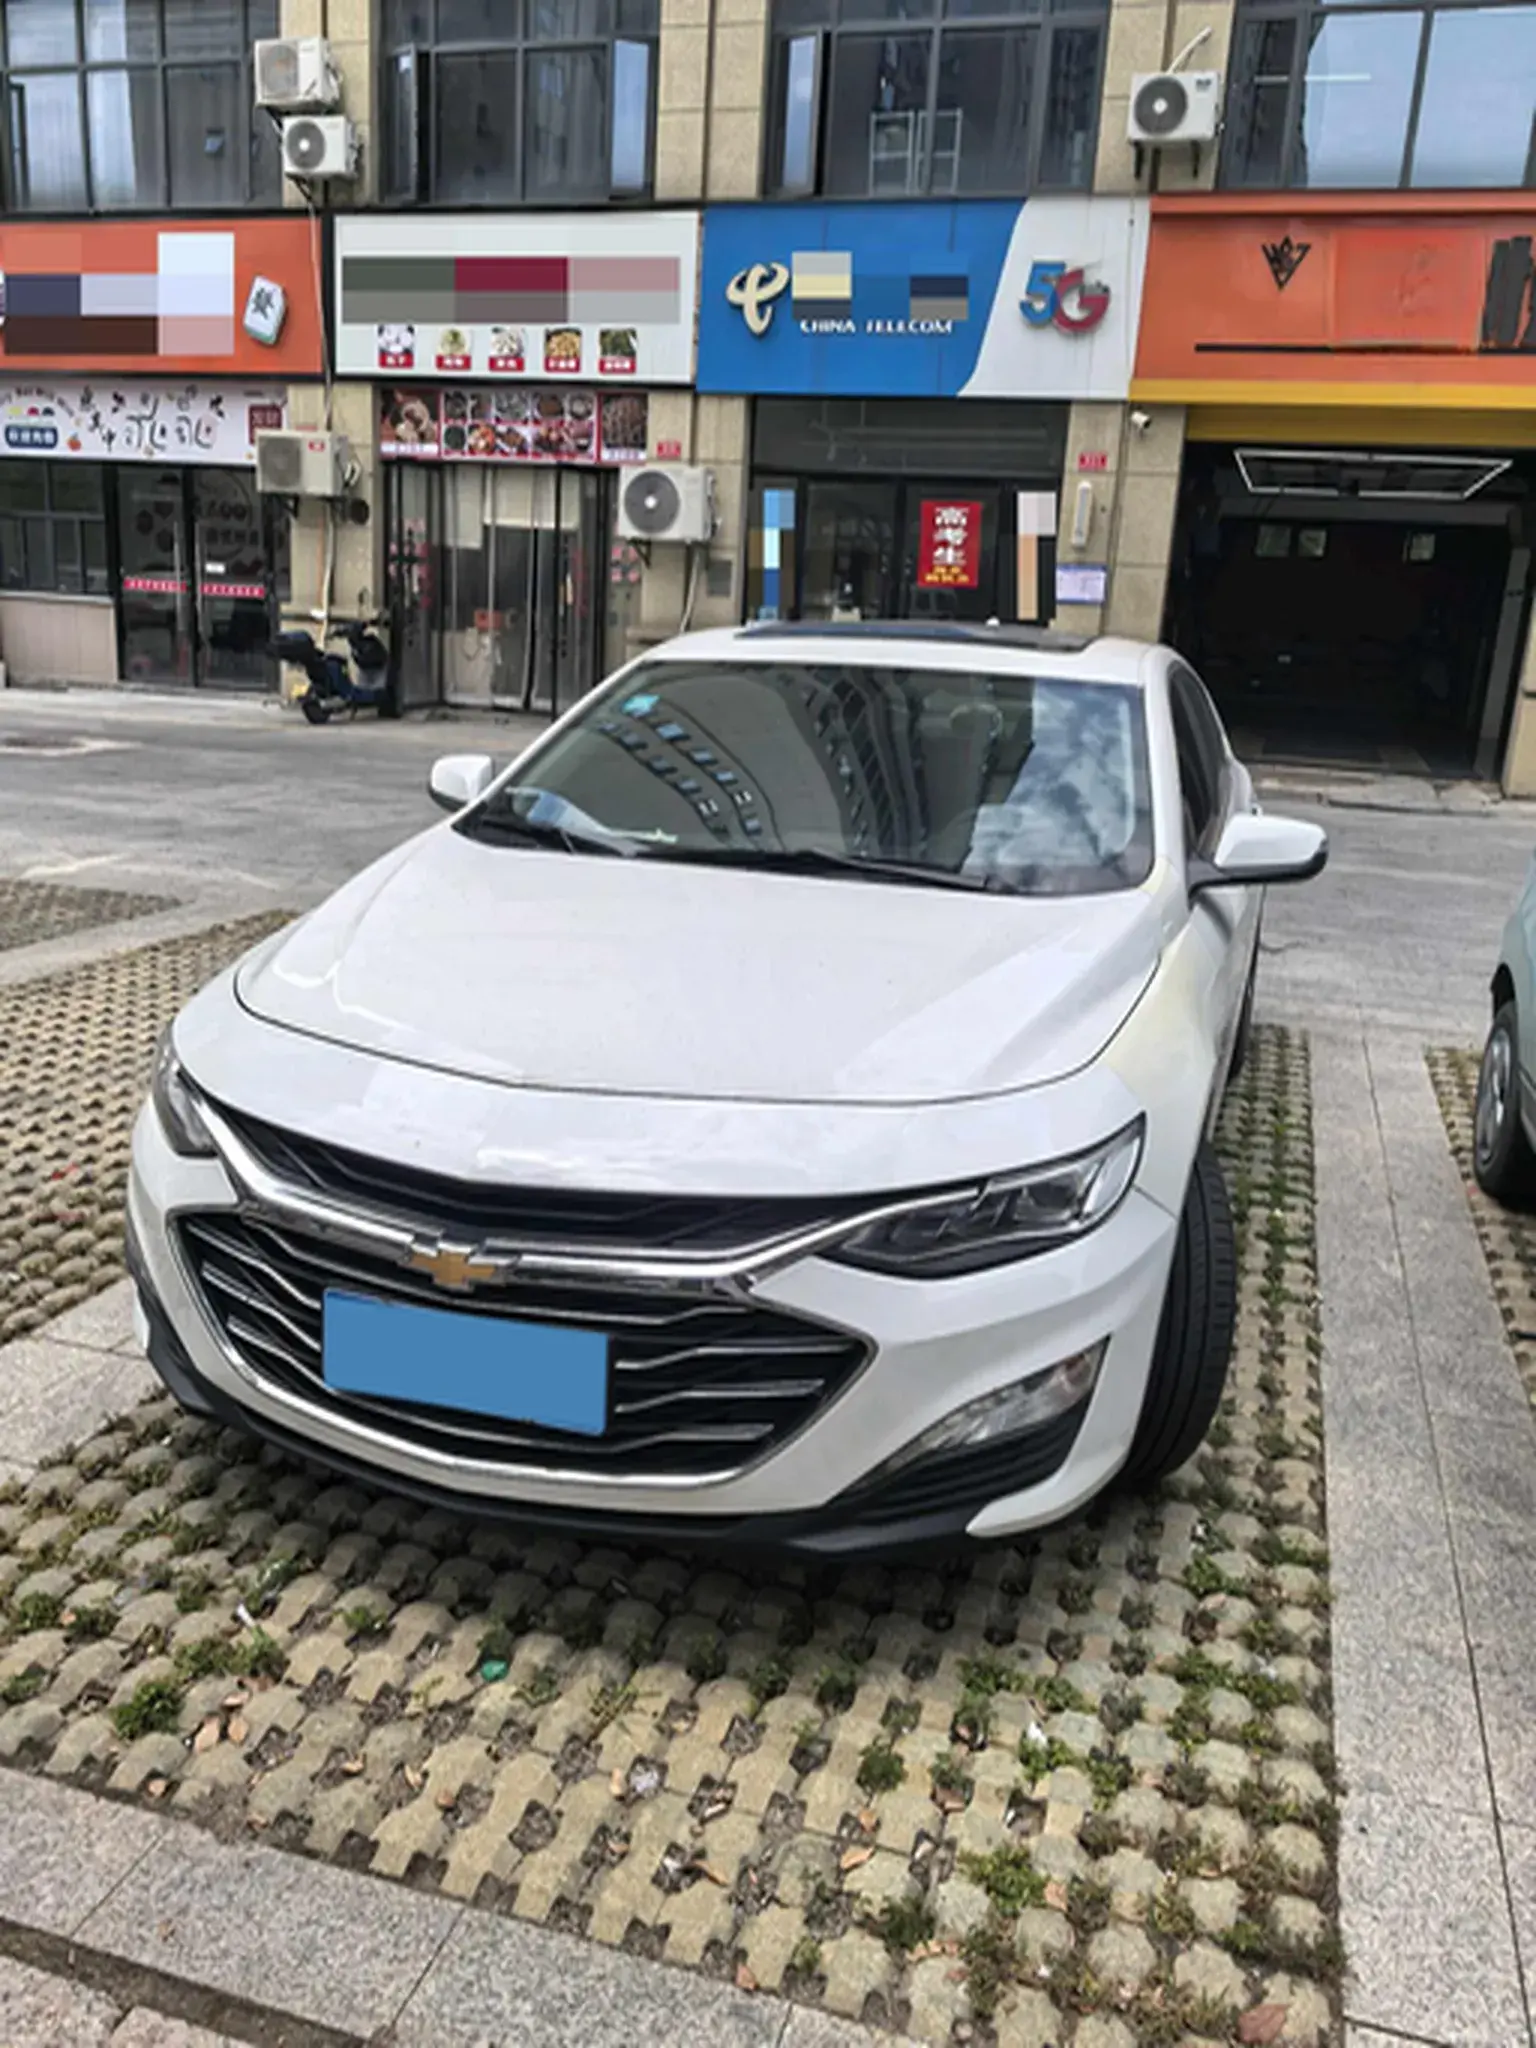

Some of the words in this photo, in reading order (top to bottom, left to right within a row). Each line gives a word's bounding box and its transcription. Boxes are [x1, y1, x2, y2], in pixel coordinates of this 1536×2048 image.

[1018, 261, 1110, 333] 5G
[799, 317, 857, 333] CHINA
[864, 318, 953, 334] TELECOM
